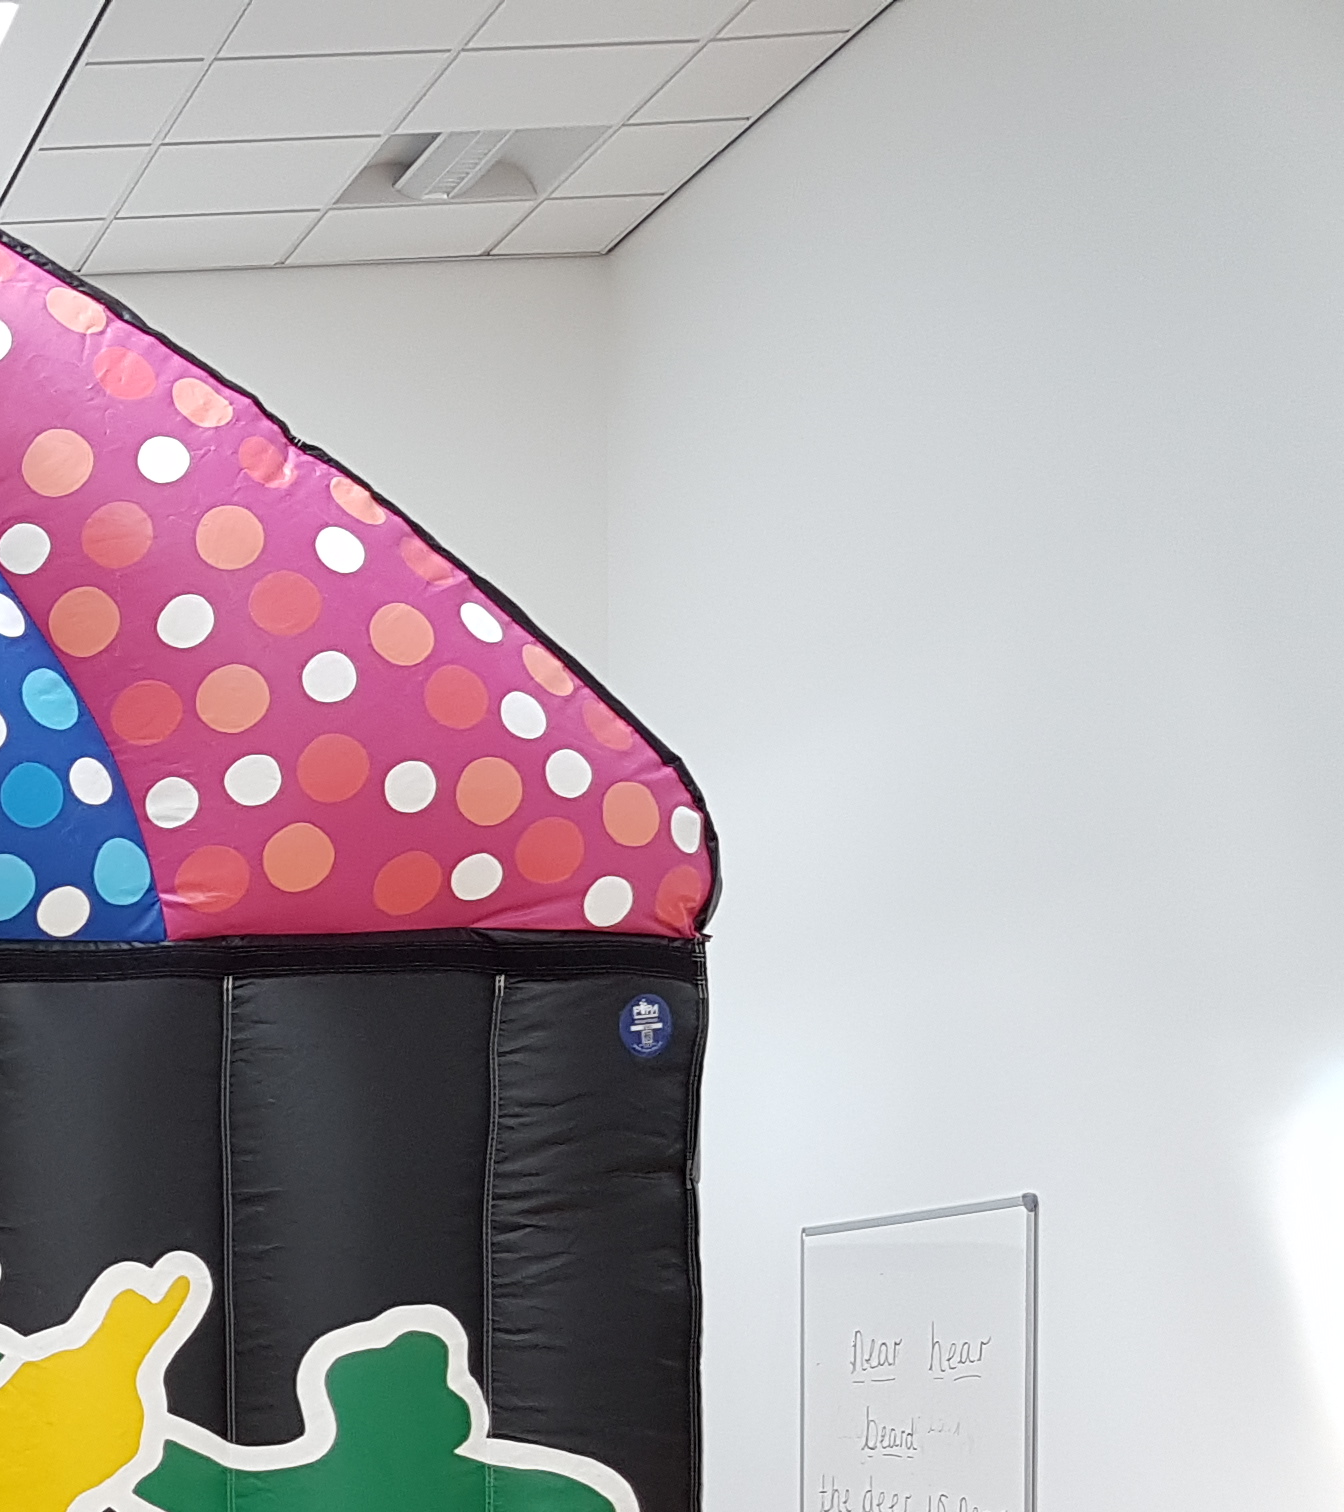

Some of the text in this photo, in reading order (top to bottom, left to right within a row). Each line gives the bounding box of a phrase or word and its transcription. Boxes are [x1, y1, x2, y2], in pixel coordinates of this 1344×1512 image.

[929, 1321, 991, 1372] hear
[861, 1406, 917, 1451] beard
[820, 1474, 852, 1512] the
